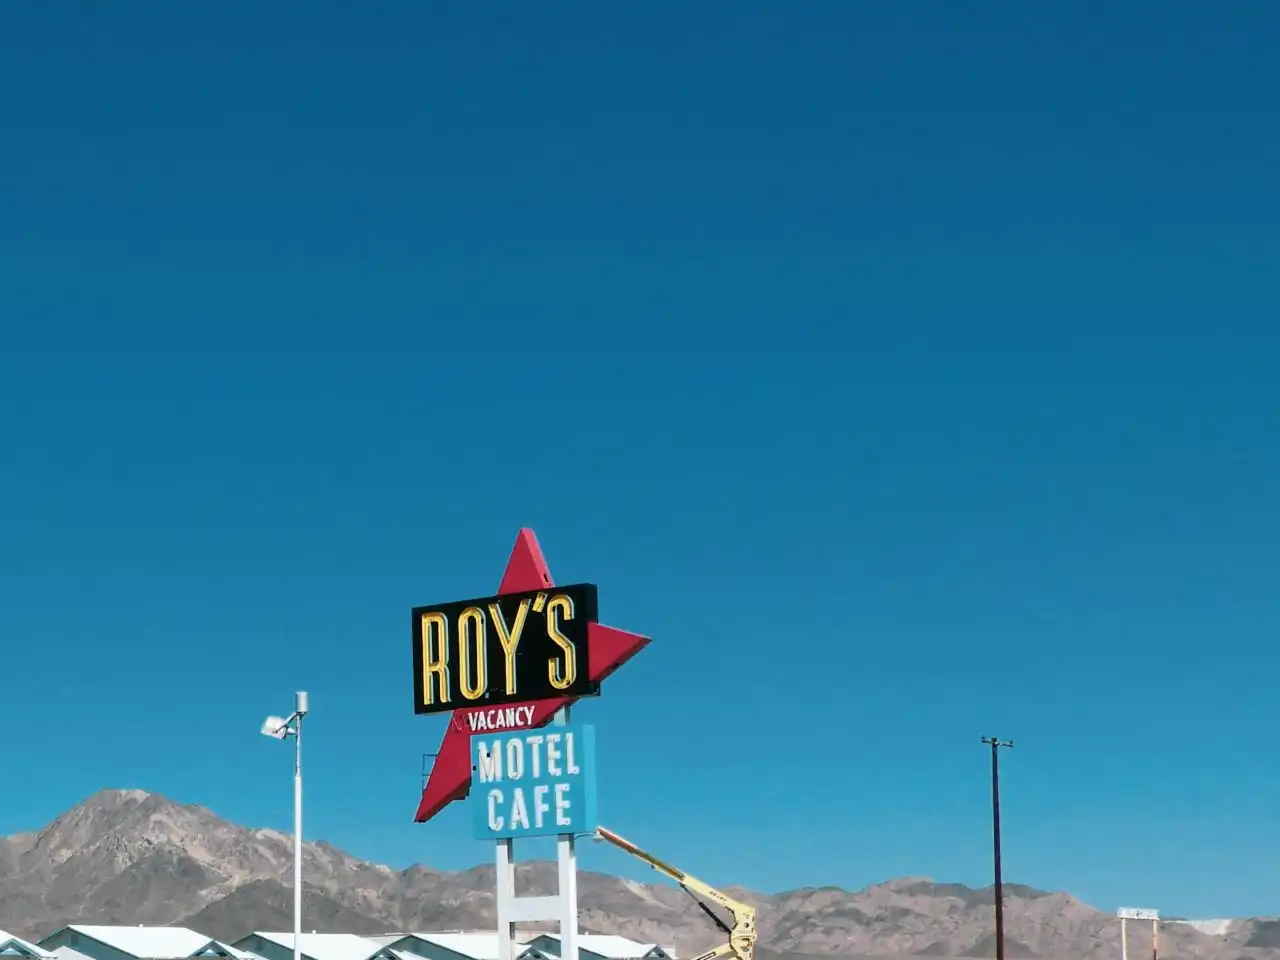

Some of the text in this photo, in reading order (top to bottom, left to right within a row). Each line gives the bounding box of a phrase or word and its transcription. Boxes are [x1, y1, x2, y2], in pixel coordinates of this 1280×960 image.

[421, 592, 577, 705] ROY'S
[468, 705, 535, 731] VACANCY
[478, 732, 580, 783] MOTEL
[487, 783, 571, 831] CAFE
